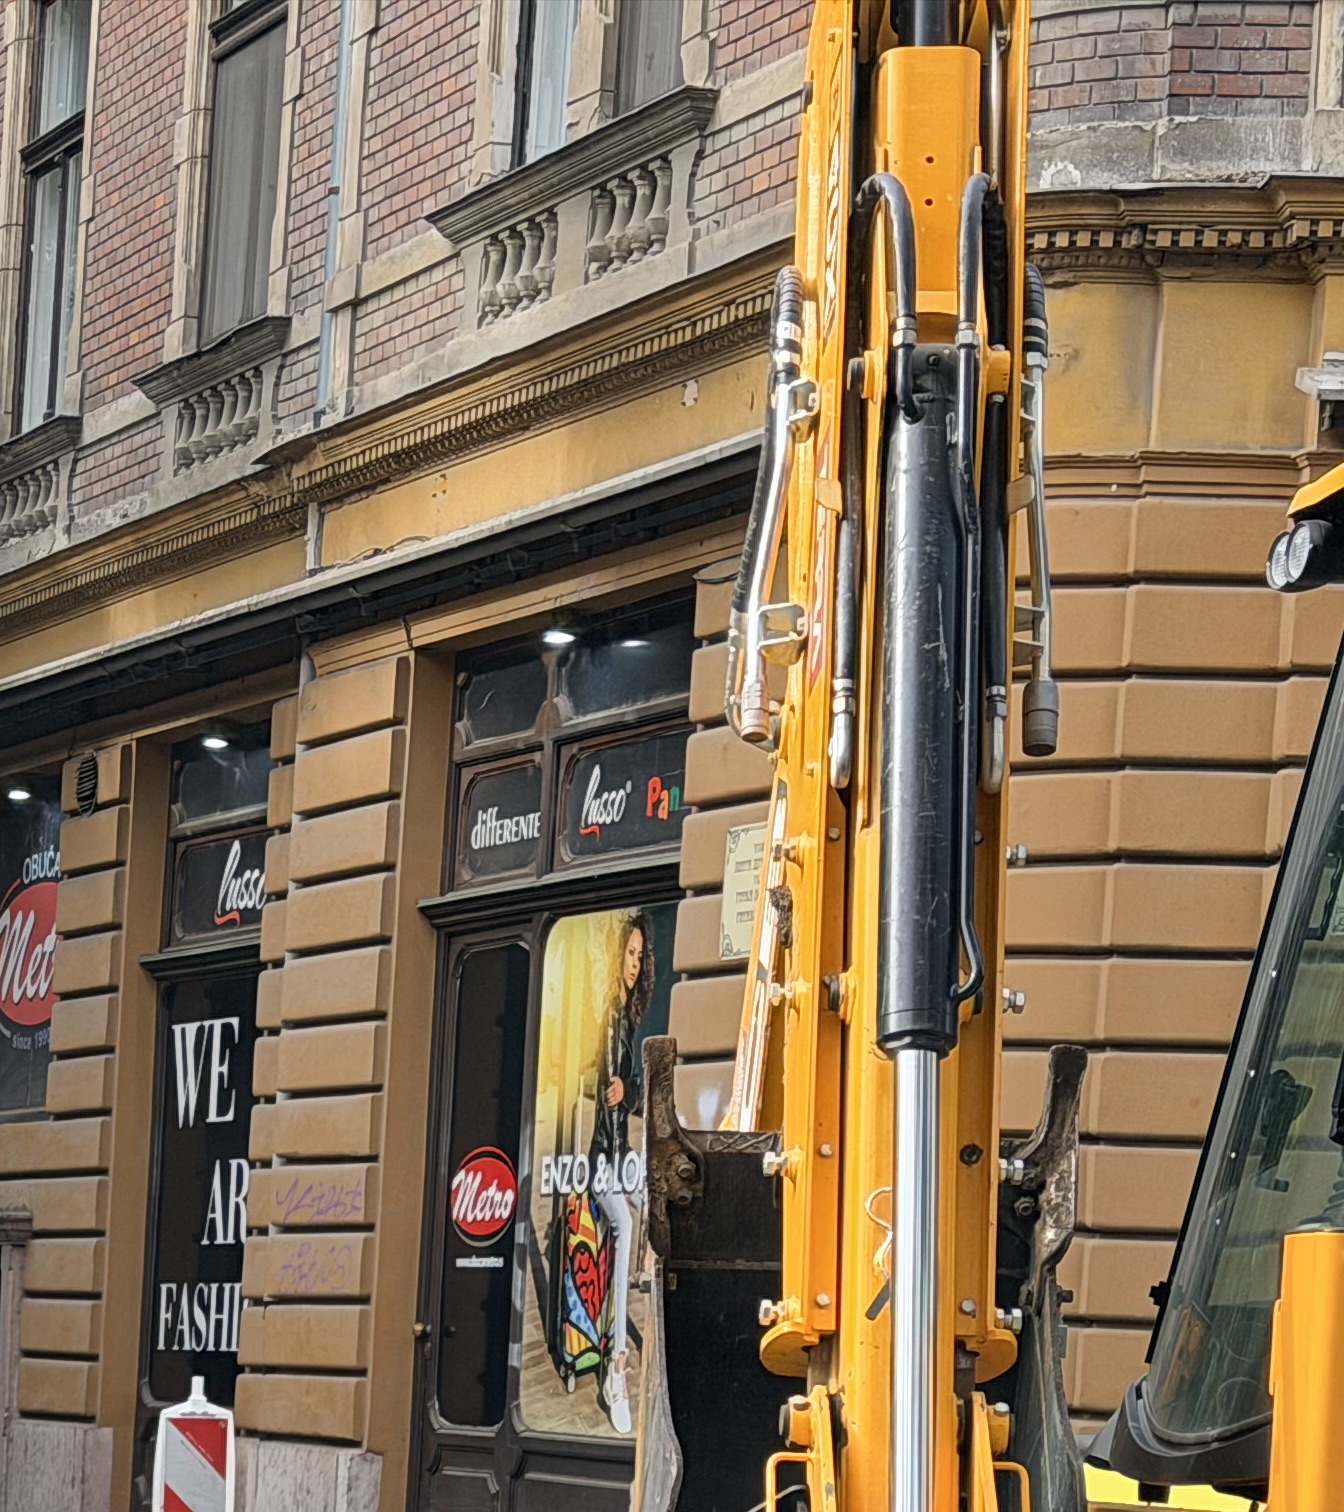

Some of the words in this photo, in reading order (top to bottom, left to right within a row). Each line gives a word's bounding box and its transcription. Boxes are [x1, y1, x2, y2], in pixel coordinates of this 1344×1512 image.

[172, 1017, 240, 1129] WE
[452, 1168, 514, 1223] Metro
[541, 1153, 589, 1195] ENZO
[594, 1153, 608, 1192] &
